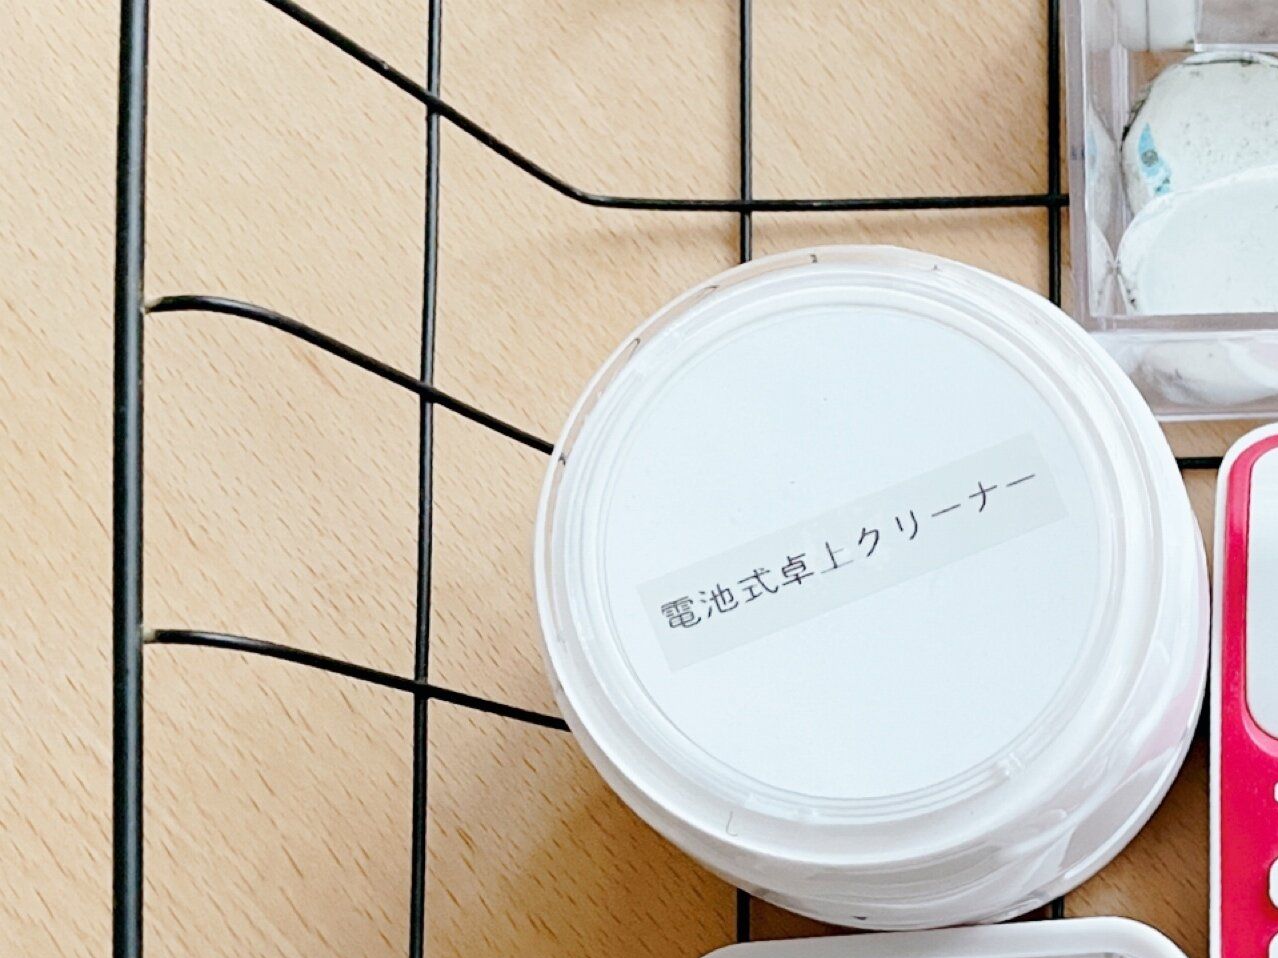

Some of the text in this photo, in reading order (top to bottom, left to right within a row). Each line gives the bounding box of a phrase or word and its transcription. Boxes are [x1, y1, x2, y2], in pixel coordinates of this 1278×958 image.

[660, 473, 1036, 630] 電池式卓上クリーナー
